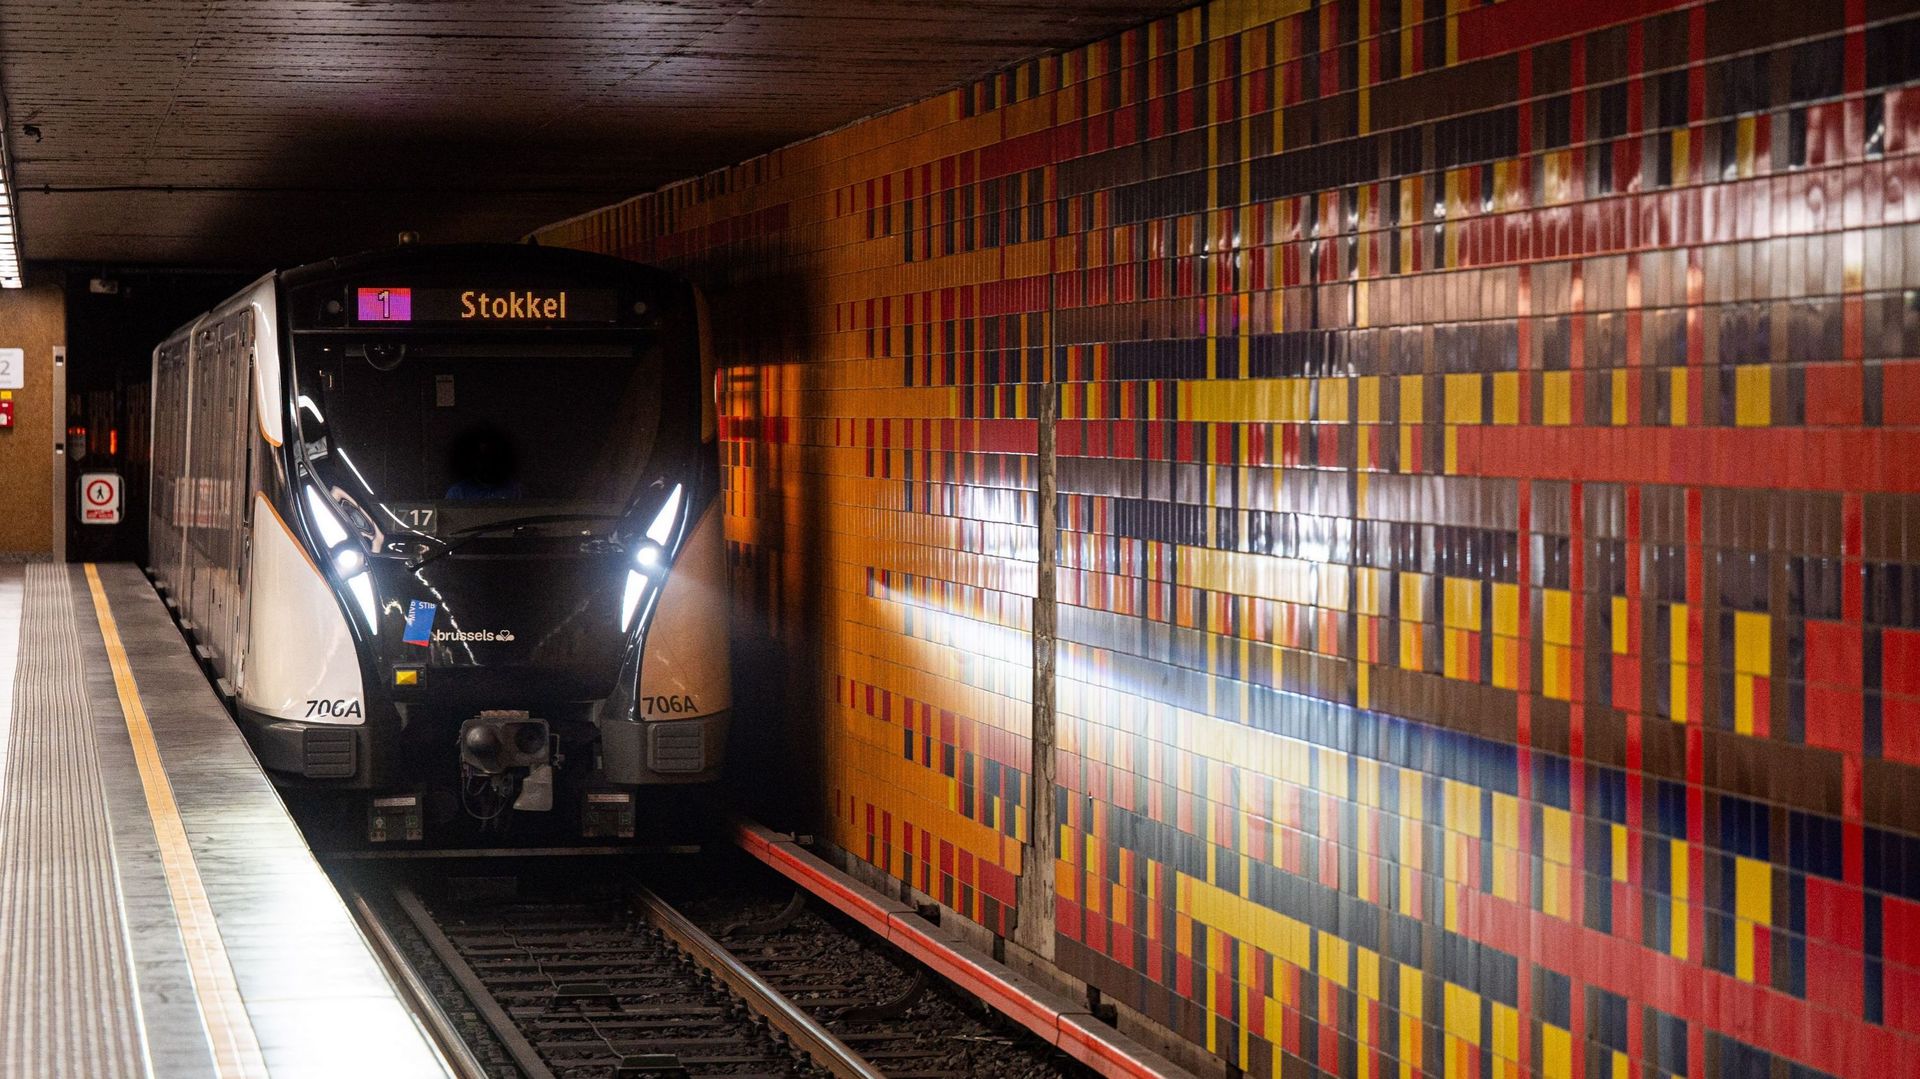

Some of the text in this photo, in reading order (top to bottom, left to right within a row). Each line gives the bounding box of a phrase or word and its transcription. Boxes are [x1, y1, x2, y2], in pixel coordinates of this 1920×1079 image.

[378, 289, 566, 319] 1 Stokkel
[418, 601, 436, 610] STIB
[305, 699, 362, 718] 706A
[642, 695, 699, 715] 706A
